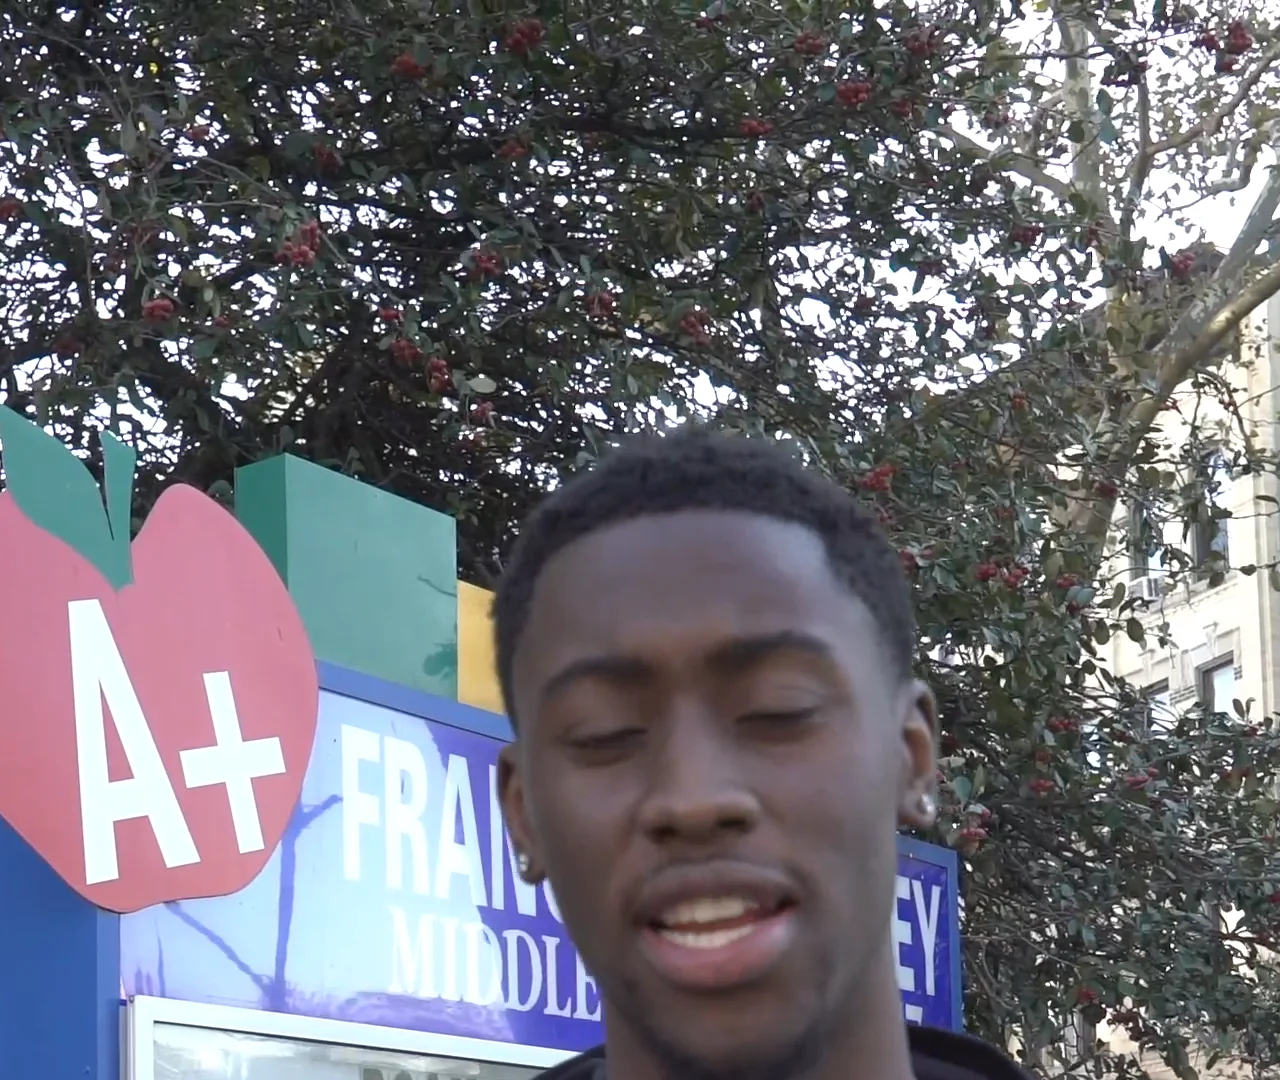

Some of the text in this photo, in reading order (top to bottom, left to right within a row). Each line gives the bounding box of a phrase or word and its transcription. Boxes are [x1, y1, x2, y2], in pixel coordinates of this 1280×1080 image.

[67, 597, 287, 886] A+
[340, 723, 565, 925] FRAN
[388, 904, 602, 1023] MIDDLE
